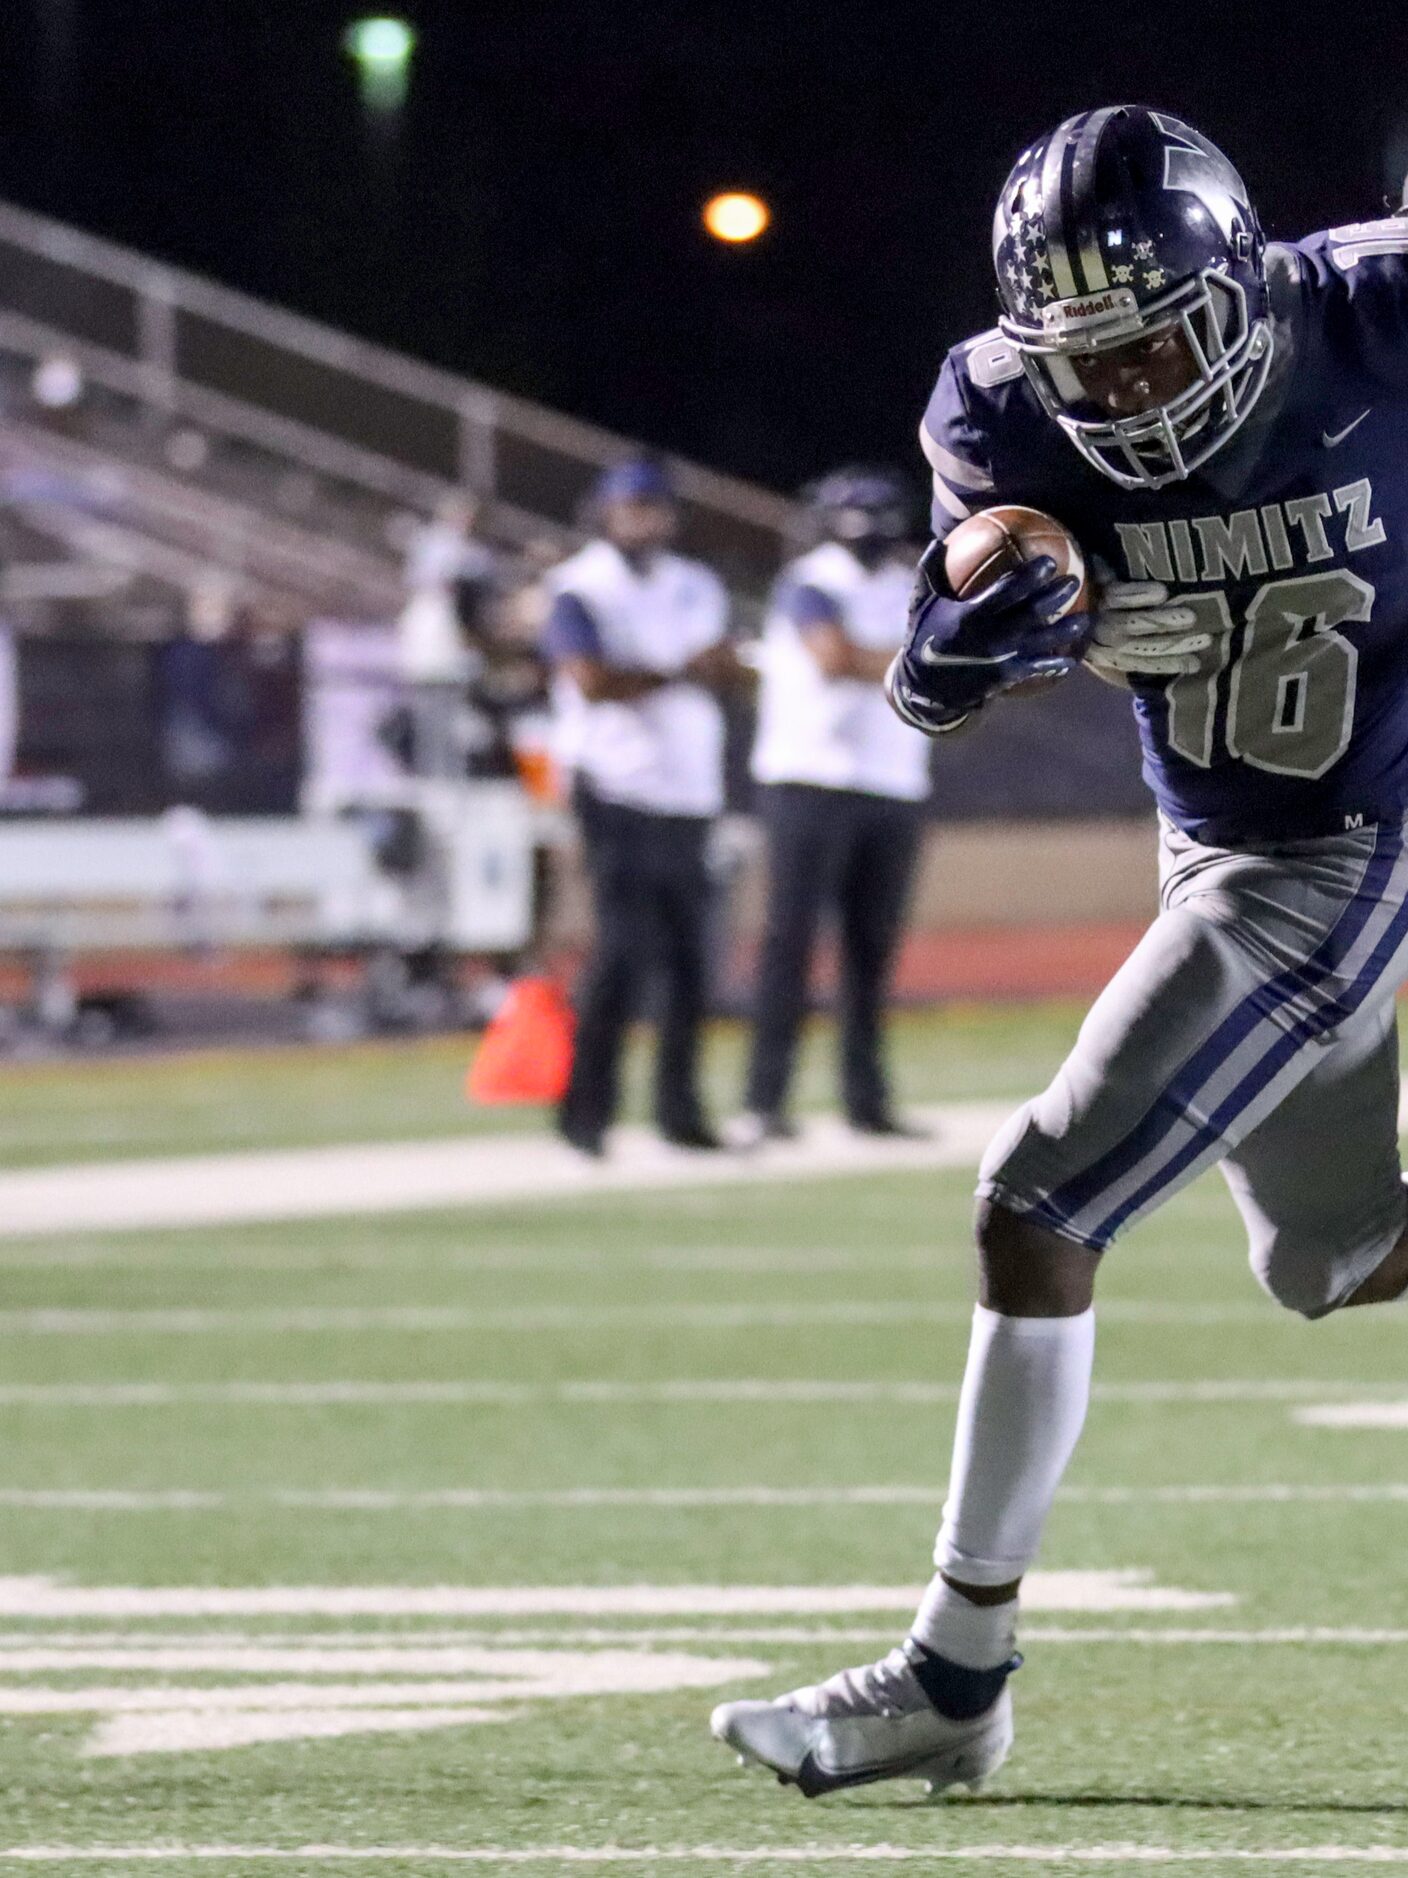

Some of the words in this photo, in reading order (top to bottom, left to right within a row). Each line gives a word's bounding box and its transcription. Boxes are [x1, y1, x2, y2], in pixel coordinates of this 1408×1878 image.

[1062, 293, 1116, 319] Riddell
[1114, 477, 1388, 583] NIMITZ
[1344, 812, 1364, 830] M
